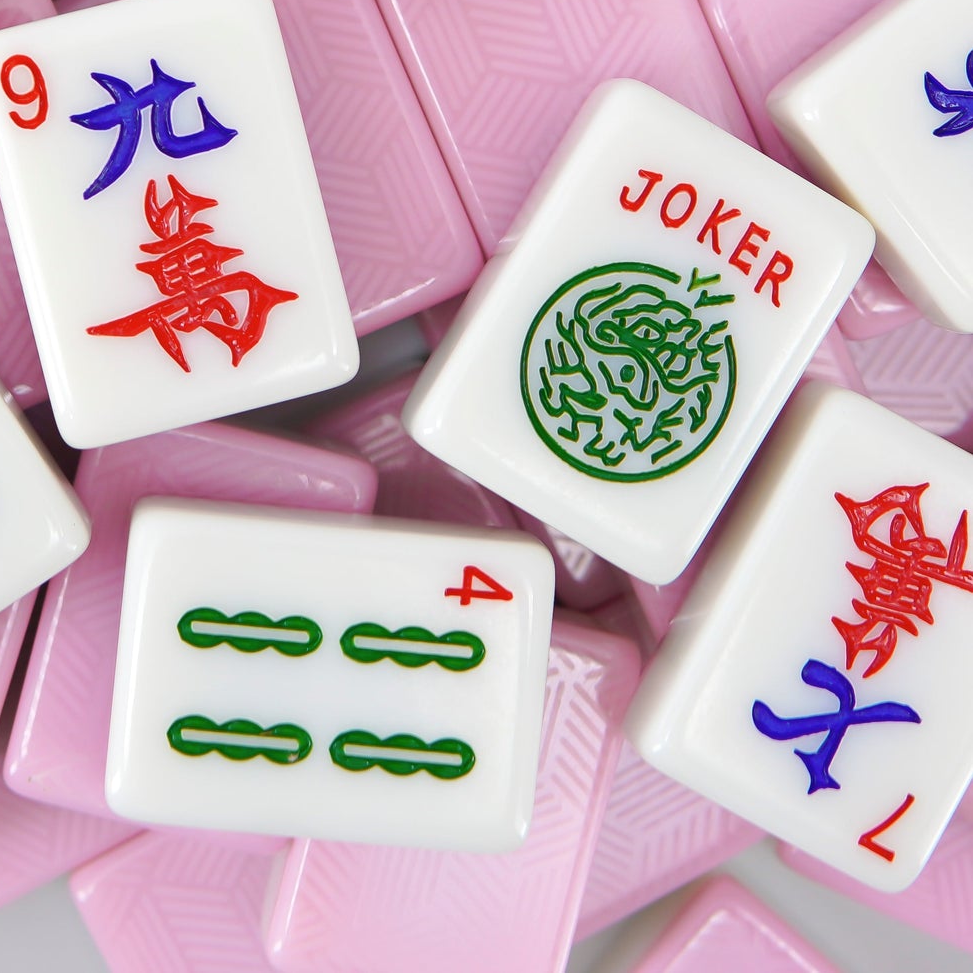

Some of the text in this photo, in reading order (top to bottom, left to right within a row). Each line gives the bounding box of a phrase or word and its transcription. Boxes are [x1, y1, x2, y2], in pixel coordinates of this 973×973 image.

[0, 55, 48, 129] 9
[620, 170, 793, 307] JOKER
[445, 566, 513, 606] 4
[859, 796, 914, 862] 7
